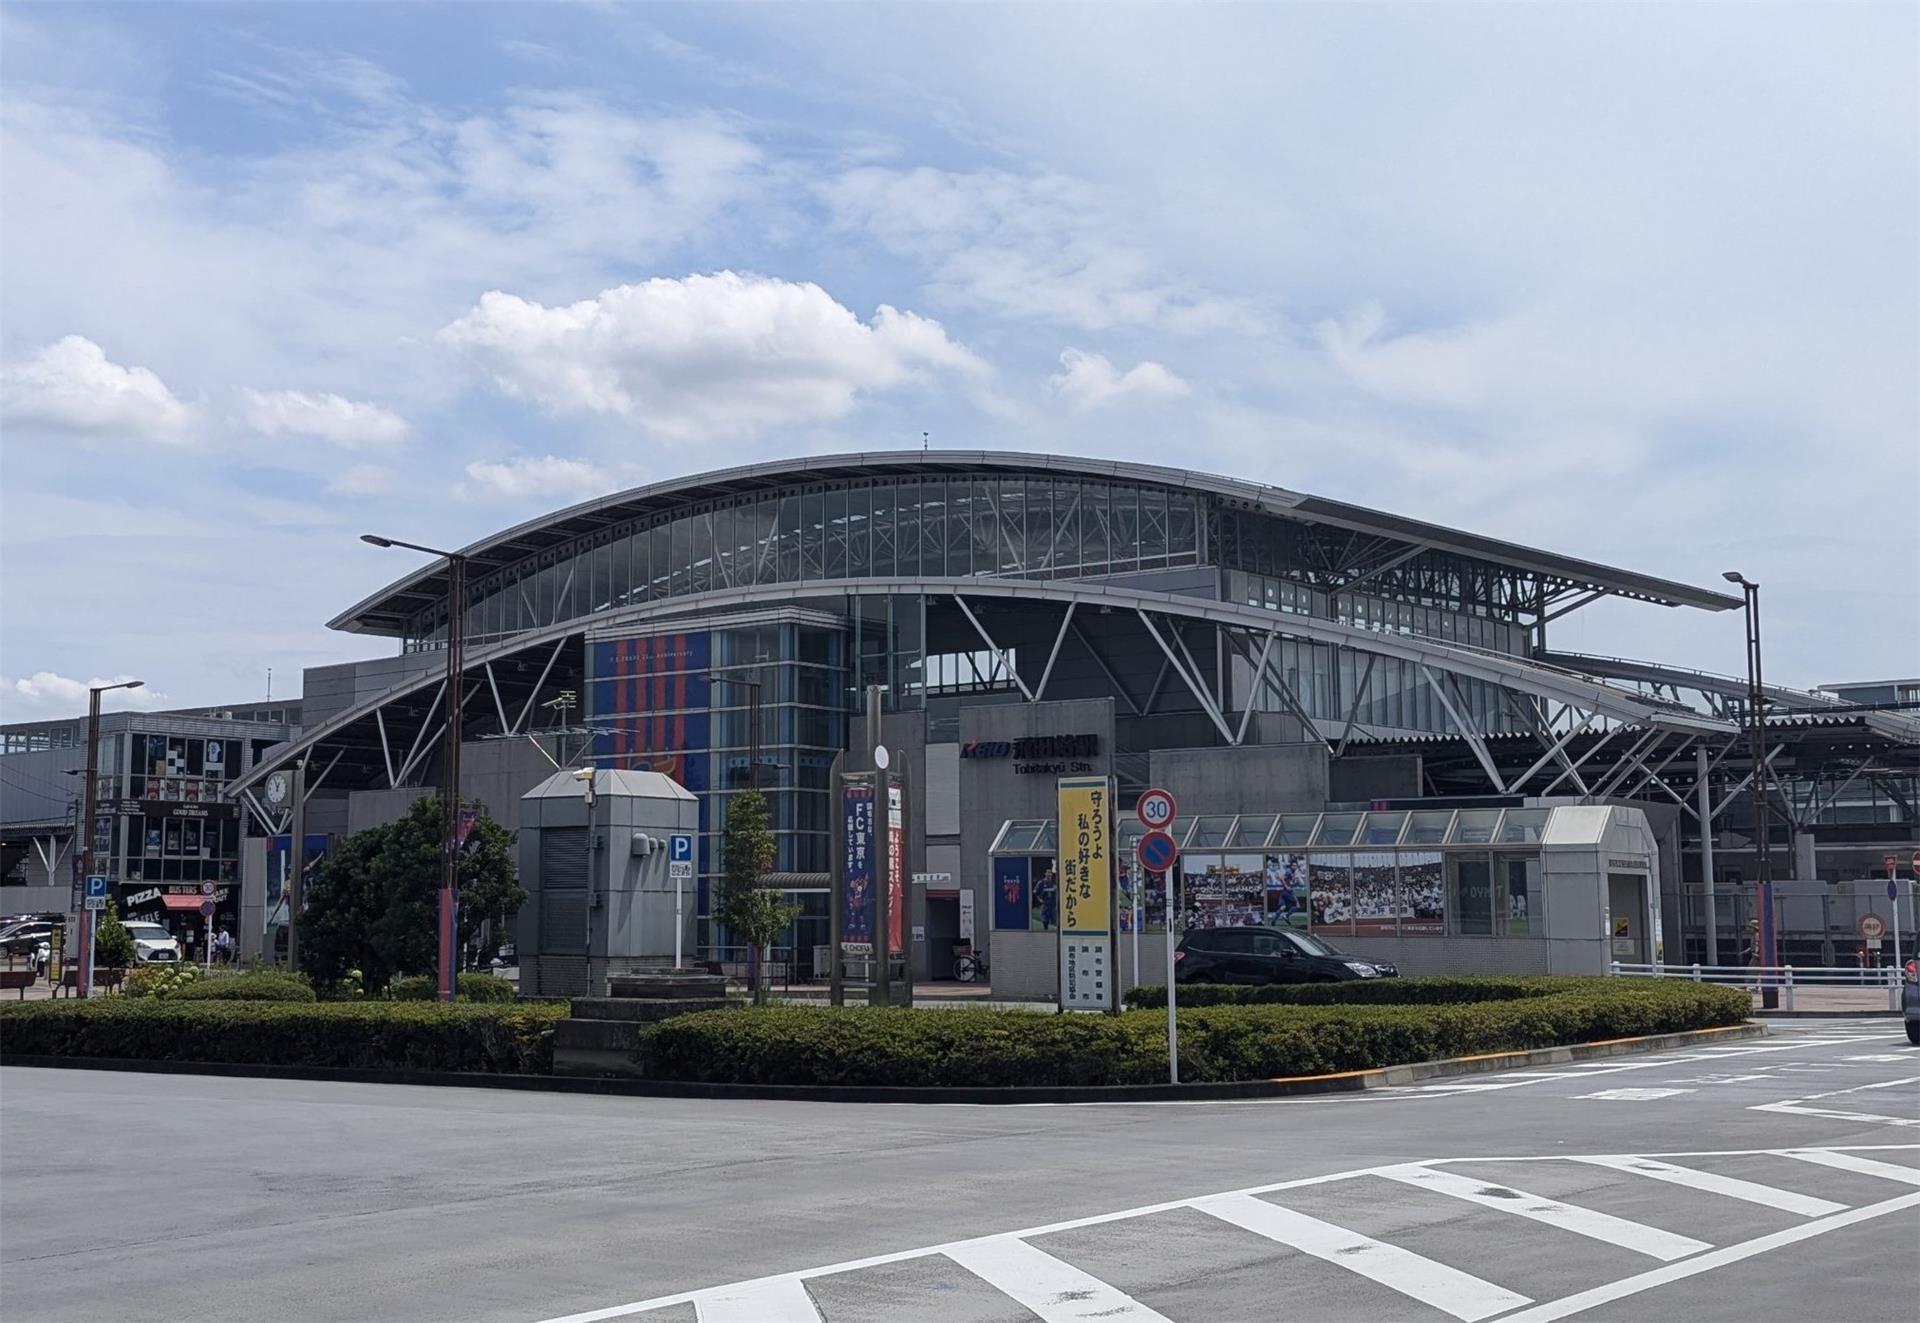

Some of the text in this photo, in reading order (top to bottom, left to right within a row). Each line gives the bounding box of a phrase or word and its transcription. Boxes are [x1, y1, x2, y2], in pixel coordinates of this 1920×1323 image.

[1146, 801, 1167, 818] 30
[1091, 790, 1103, 859] 守ろうよ
[676, 837, 688, 859] P
[1077, 813, 1091, 899] 私の好きな
[91, 878, 103, 895] P
[127, 887, 161, 906] PIZZA
[1065, 859, 1077, 927] 街だから
